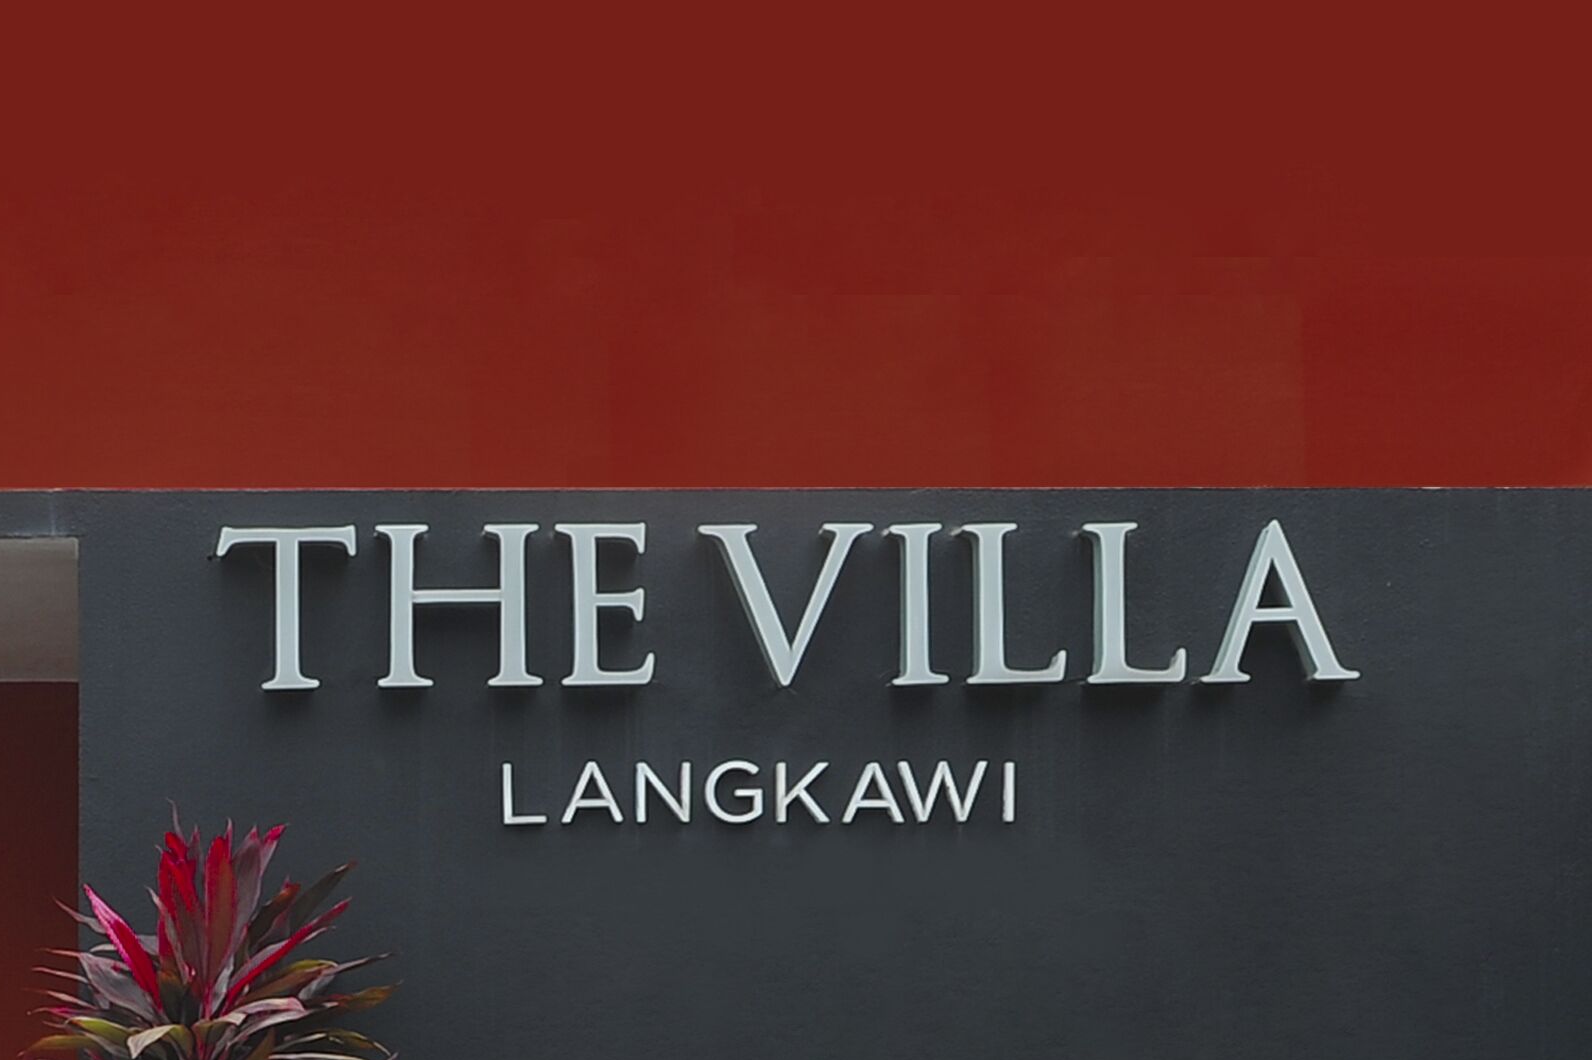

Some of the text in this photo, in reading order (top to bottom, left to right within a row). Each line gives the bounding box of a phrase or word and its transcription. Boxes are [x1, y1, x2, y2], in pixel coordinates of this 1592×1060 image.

[214, 518, 1362, 690] THE VILLA
[501, 760, 1017, 825] LANGKAWI
